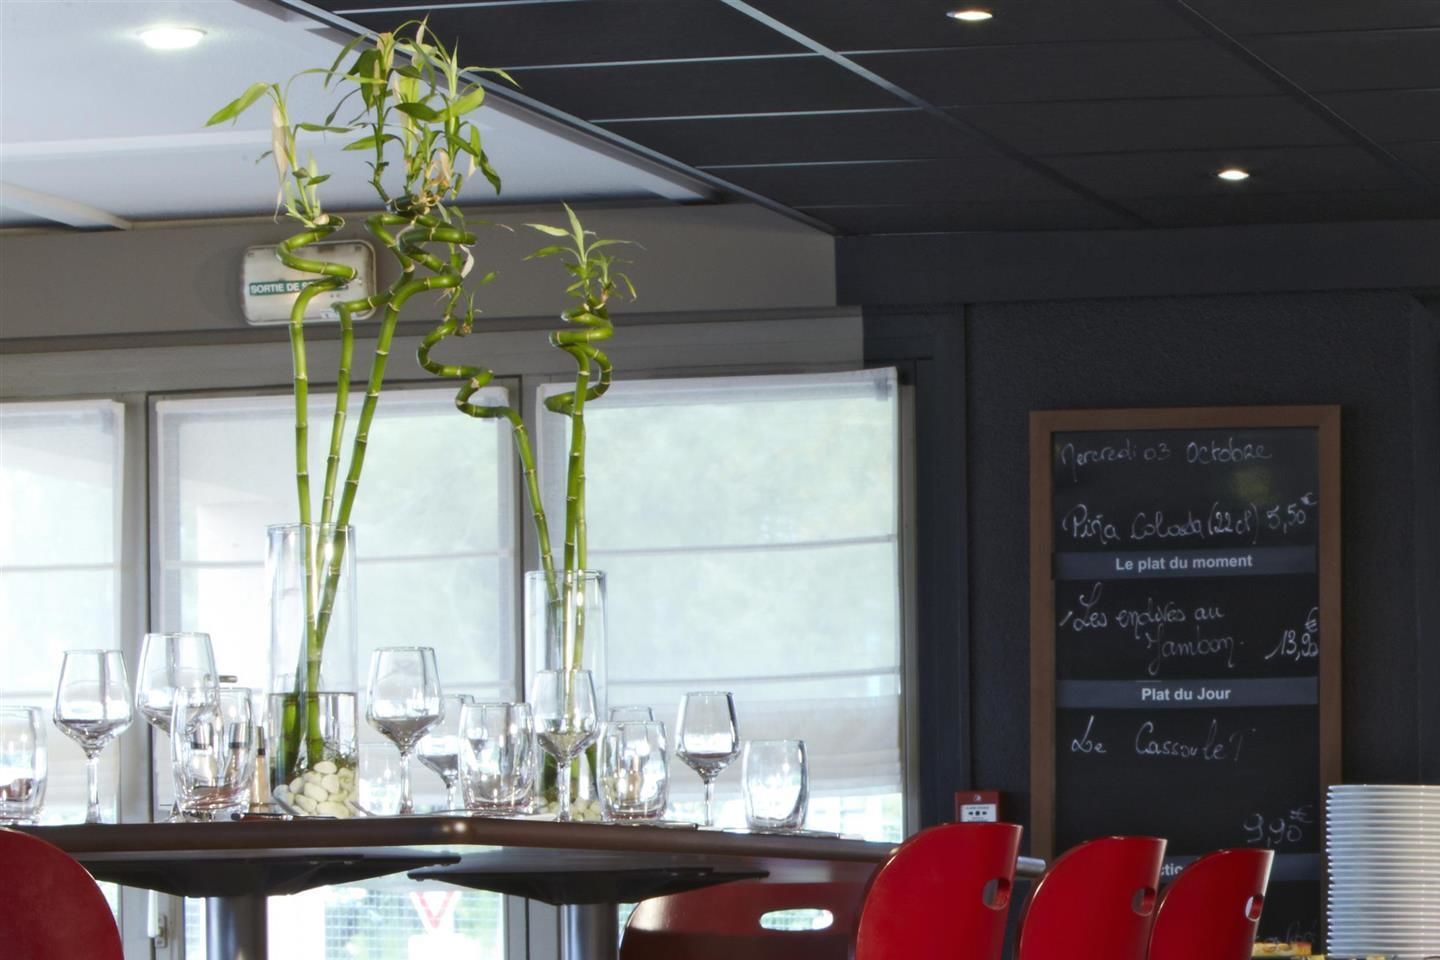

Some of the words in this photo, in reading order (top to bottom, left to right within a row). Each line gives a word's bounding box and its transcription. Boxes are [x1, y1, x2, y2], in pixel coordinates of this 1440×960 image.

[250, 282, 285, 294] SORTIE
[286, 282, 300, 292] DE
[1144, 442, 1171, 461] 03
[1130, 511, 1205, 541] Colada
[1115, 557, 1134, 571] Le
[1138, 556, 1166, 573] plat
[1169, 555, 1189, 570] du
[1192, 554, 1254, 569] moment
[1193, 606, 1225, 621] au
[1141, 687, 1170, 701] Plat
[1174, 687, 1193, 700] du
[1197, 686, 1232, 700] Jour
[1071, 714, 1107, 753] Le
